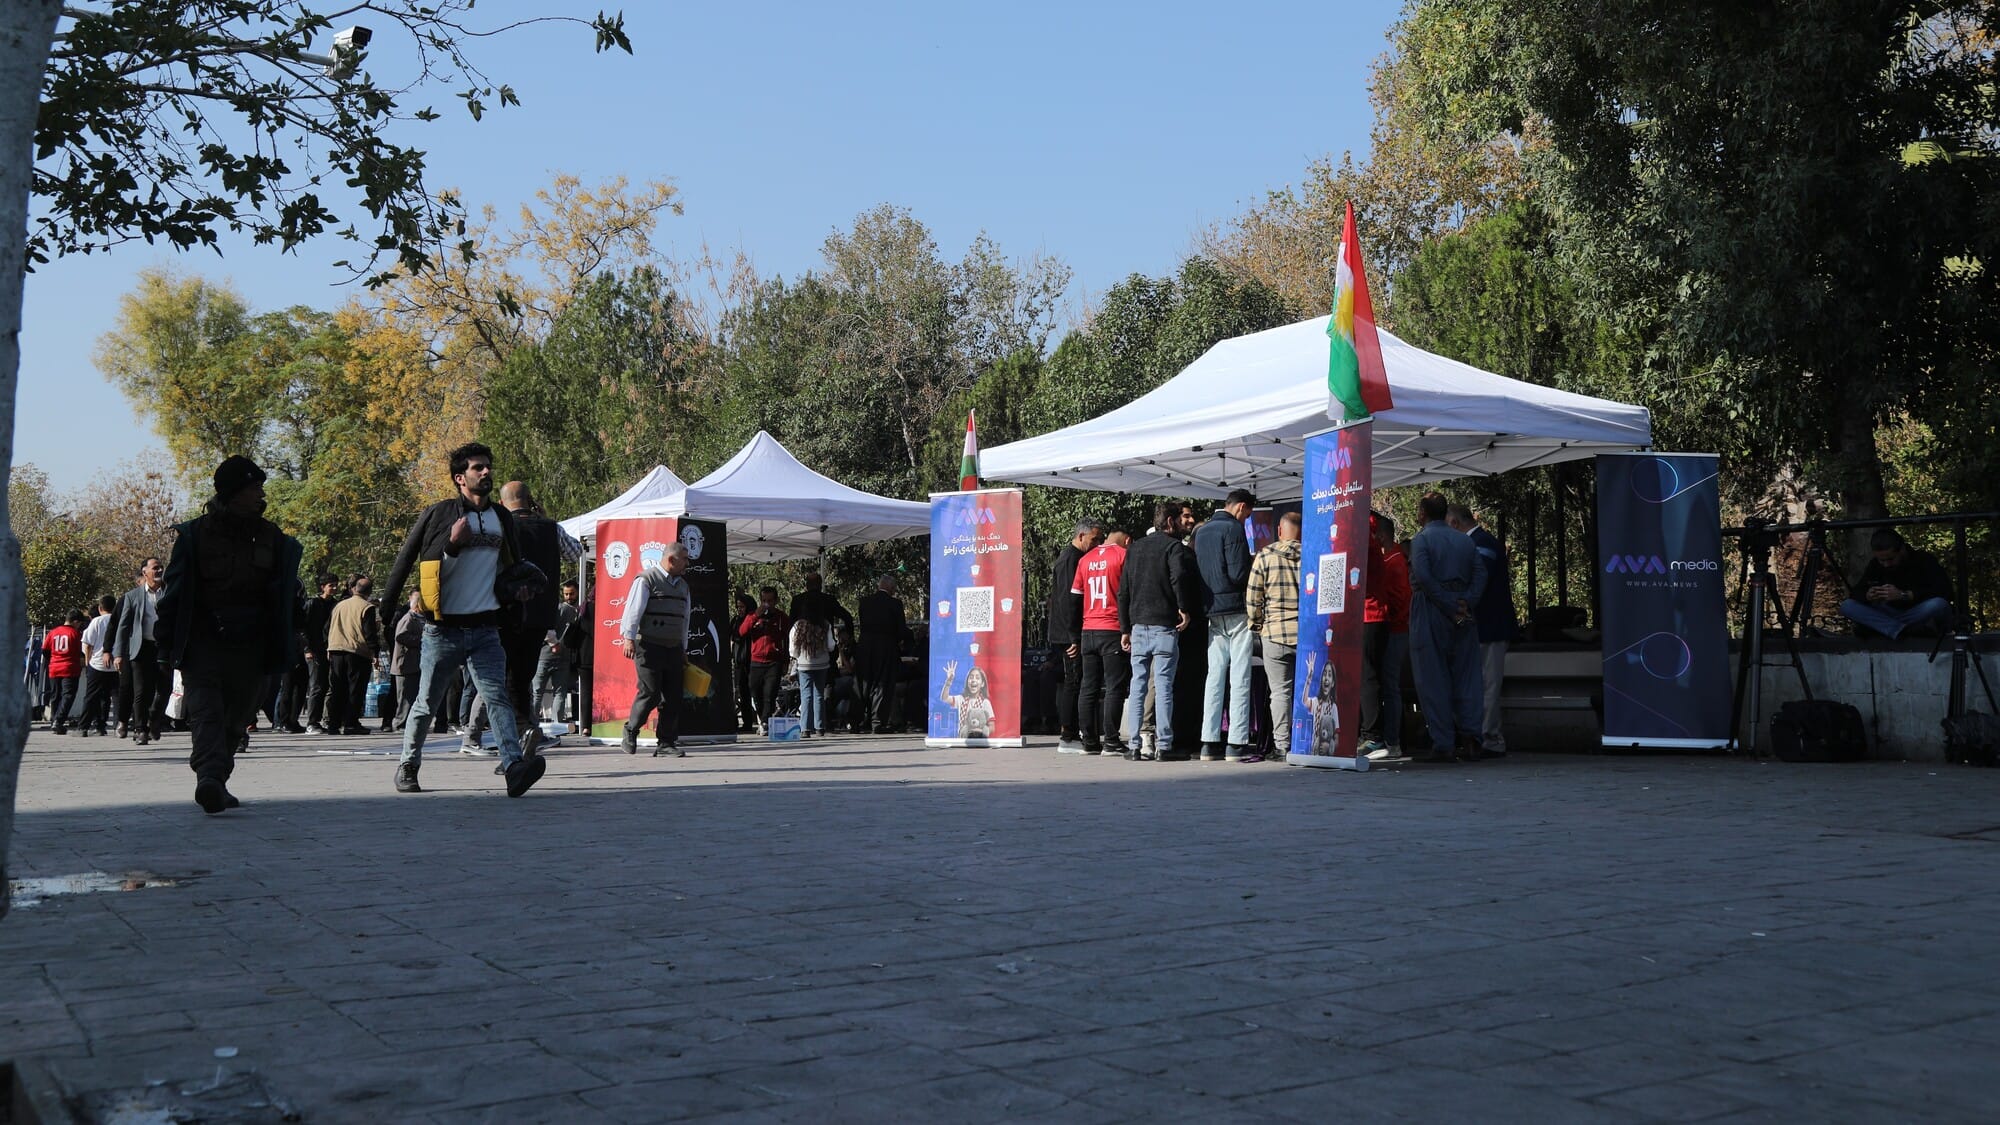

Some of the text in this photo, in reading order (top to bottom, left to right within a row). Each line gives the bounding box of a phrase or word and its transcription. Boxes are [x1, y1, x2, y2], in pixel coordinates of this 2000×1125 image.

[1322, 446, 1352, 474] AVA
[955, 507, 996, 527] AVA
[1605, 555, 1718, 574] AVA media
[1088, 575, 1107, 610] 14
[53, 634, 69, 653] 10
